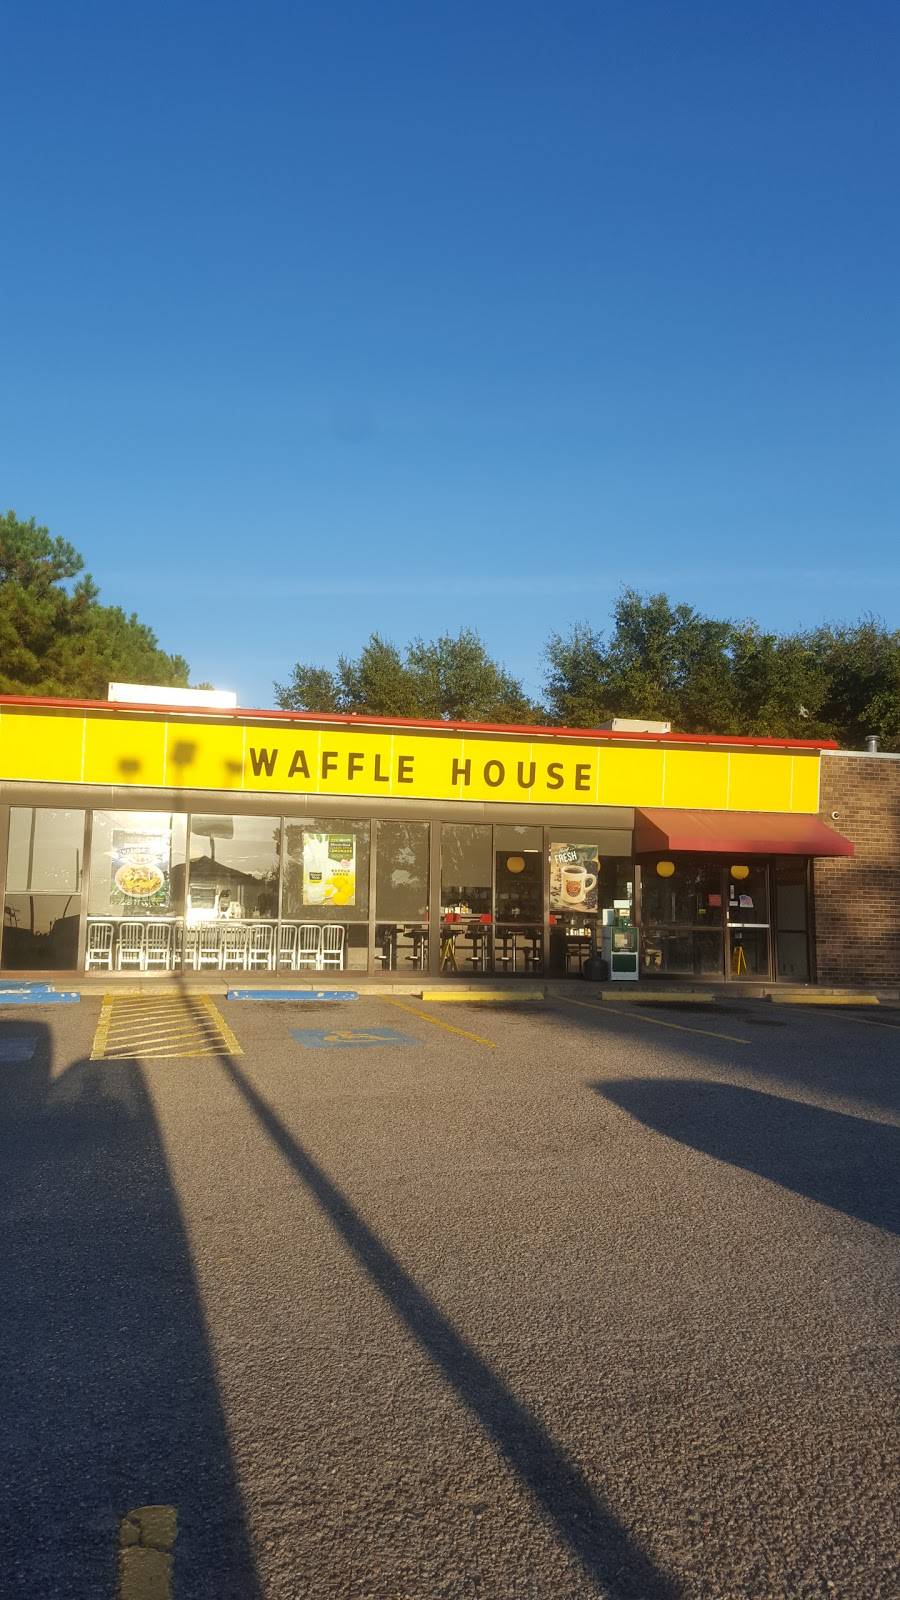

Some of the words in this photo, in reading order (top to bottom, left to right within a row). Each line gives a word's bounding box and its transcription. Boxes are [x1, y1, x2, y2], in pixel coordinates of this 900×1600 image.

[249, 748, 414, 783] WAFFLE
[452, 759, 591, 790] HOUSE
[554, 850, 578, 864] FRESH
